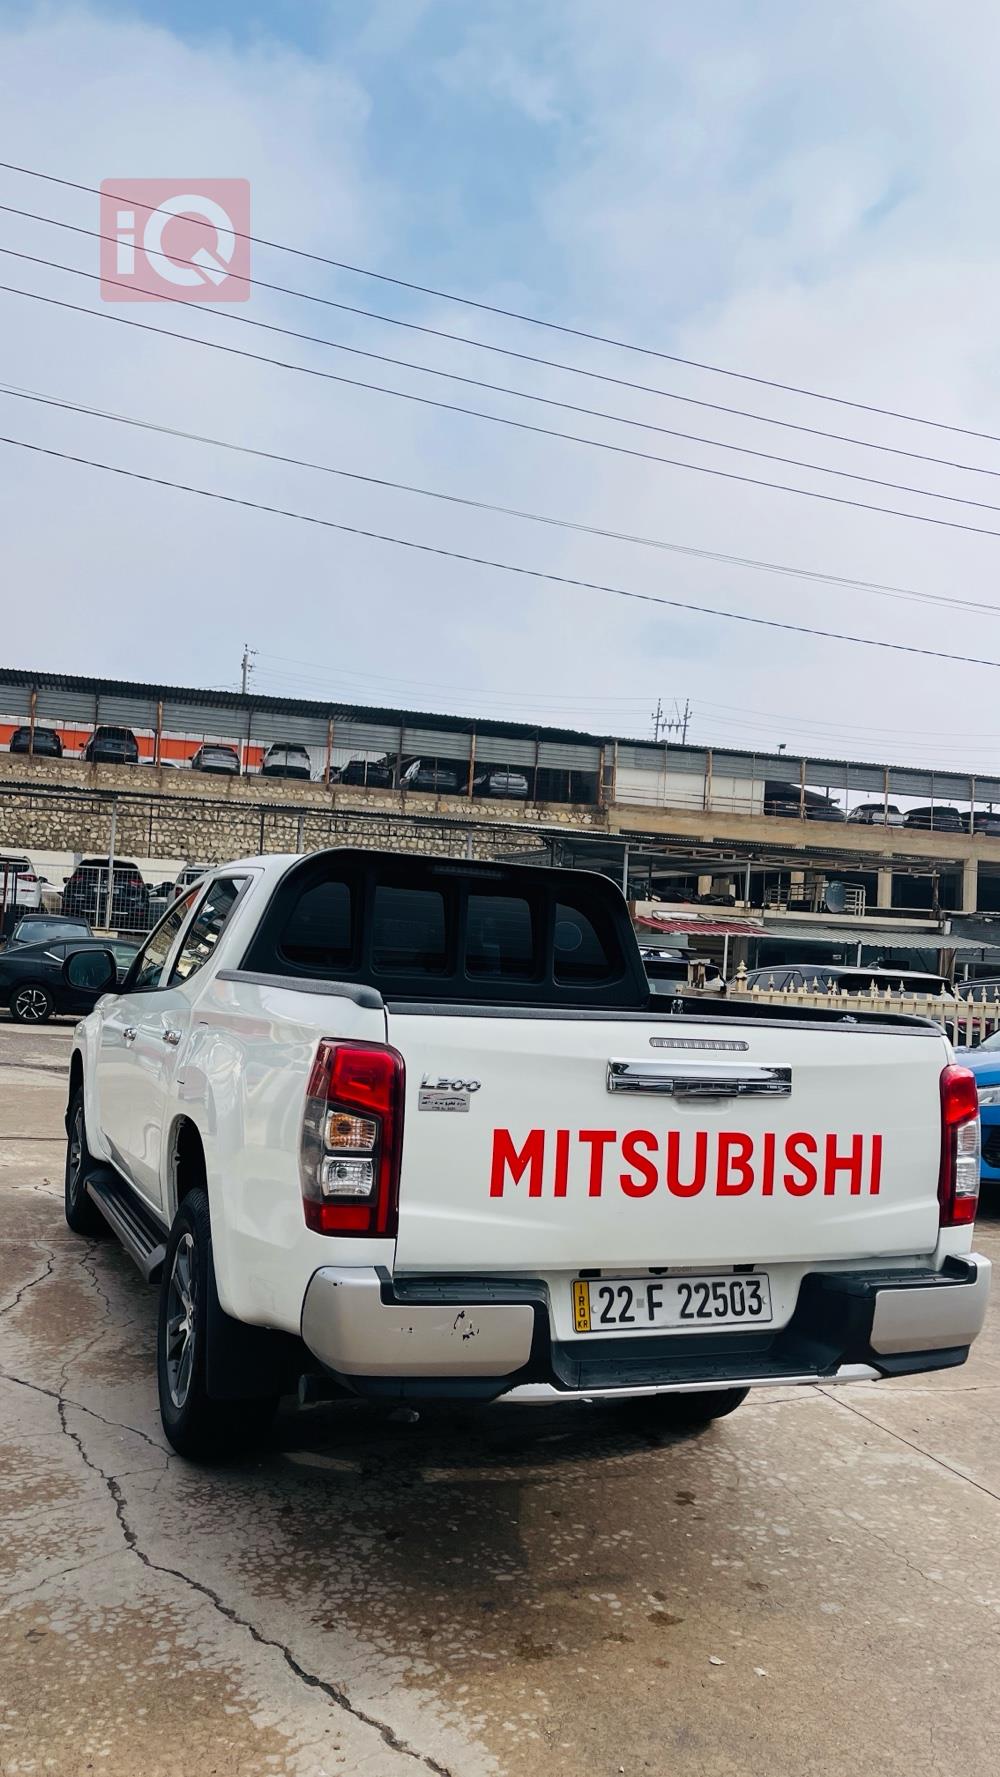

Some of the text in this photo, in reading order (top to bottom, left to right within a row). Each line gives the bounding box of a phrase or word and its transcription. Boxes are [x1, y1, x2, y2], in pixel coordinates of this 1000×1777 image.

[420, 1072, 482, 1093] L200
[490, 1128, 882, 1198] MITSUBISHI
[599, 1280, 763, 1323] 22 F 22503
